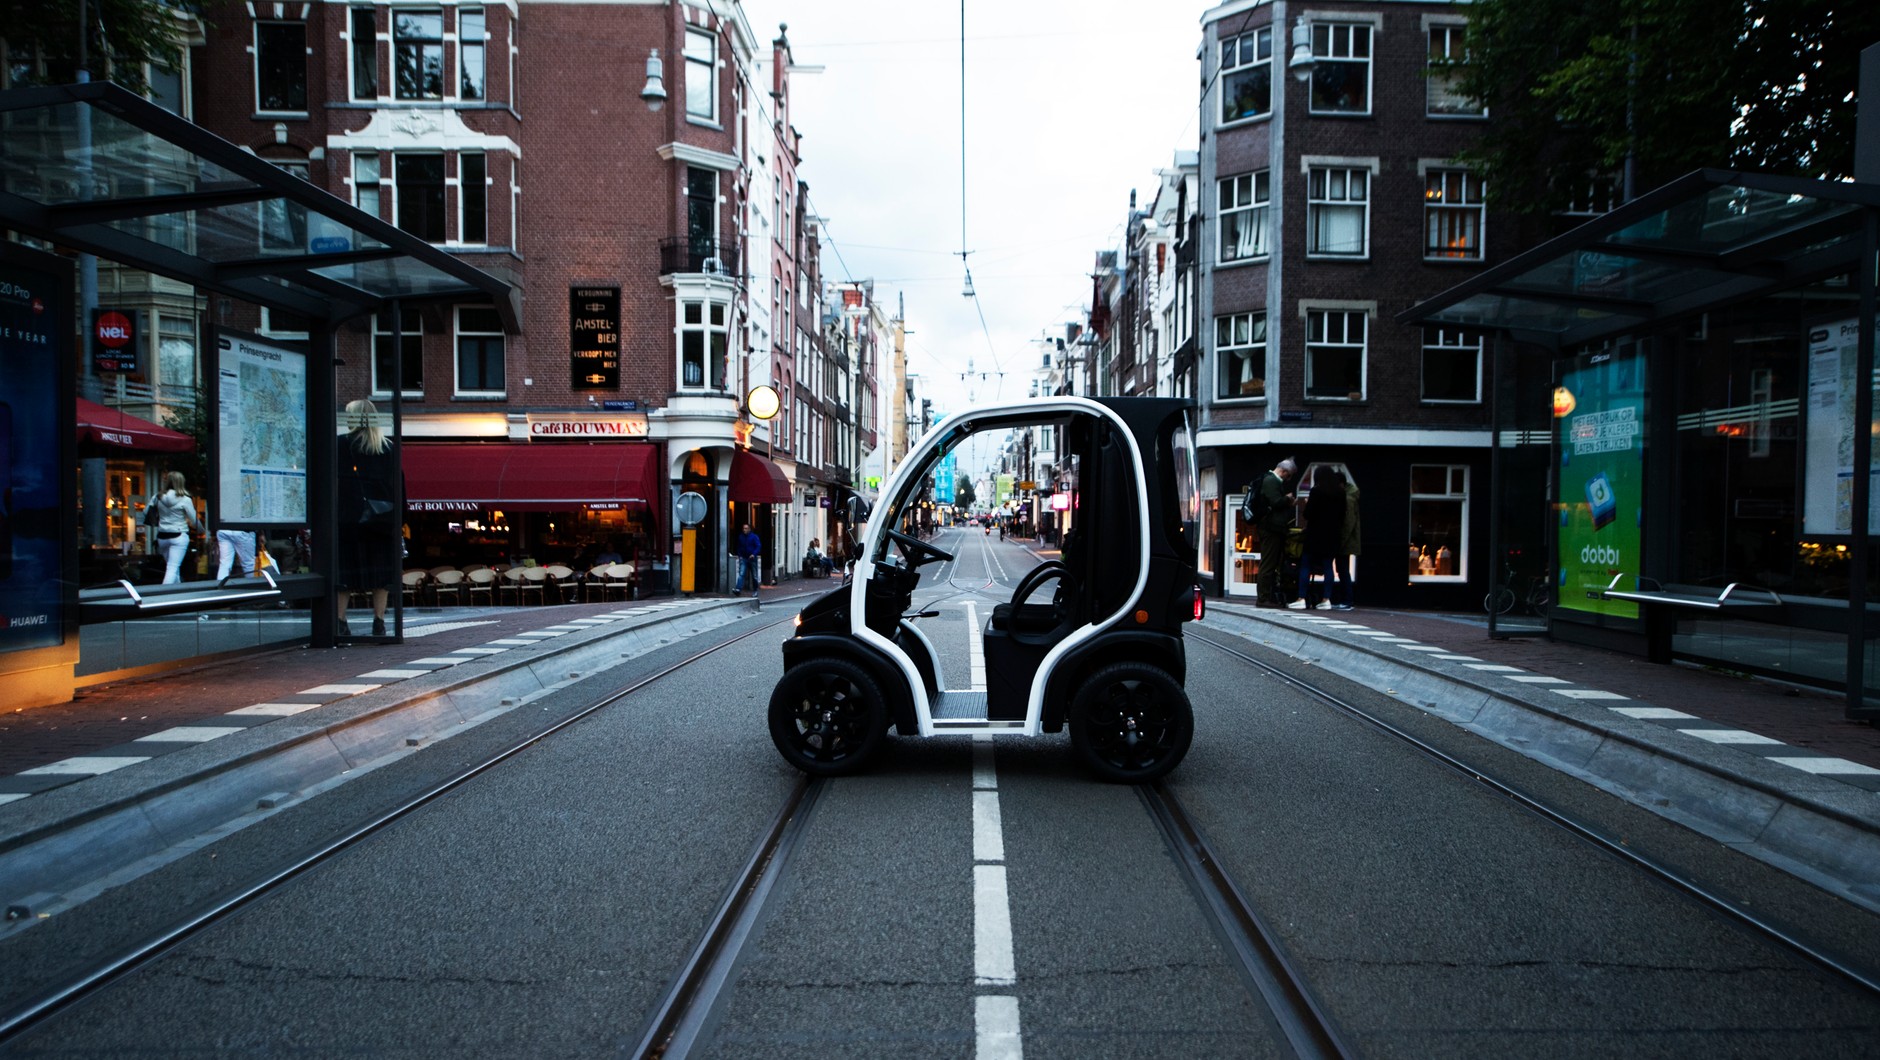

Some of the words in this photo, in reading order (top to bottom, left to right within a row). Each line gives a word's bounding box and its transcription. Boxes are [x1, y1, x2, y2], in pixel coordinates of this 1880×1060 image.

[14, 285, 30, 299] Pro
[17, 330, 47, 344] YEAR
[597, 333, 617, 344] BIER
[239, 343, 282, 362] Prinsengracht
[1586, 414, 1598, 426] EEN
[1599, 410, 1620, 424] DRUK
[1621, 409, 1633, 420] OP
[531, 422, 561, 434] Café
[562, 422, 642, 434] BOUWMAN
[1599, 426, 1607, 438] JE
[1607, 423, 1635, 436] KLEREN
[1575, 441, 1594, 454] LATEN
[1595, 438, 1629, 452] STRIJKEN
[424, 502, 479, 511] BOUWMAN
[1581, 544, 1620, 566] dobbi
[10, 614, 48, 627] HUAWEI
